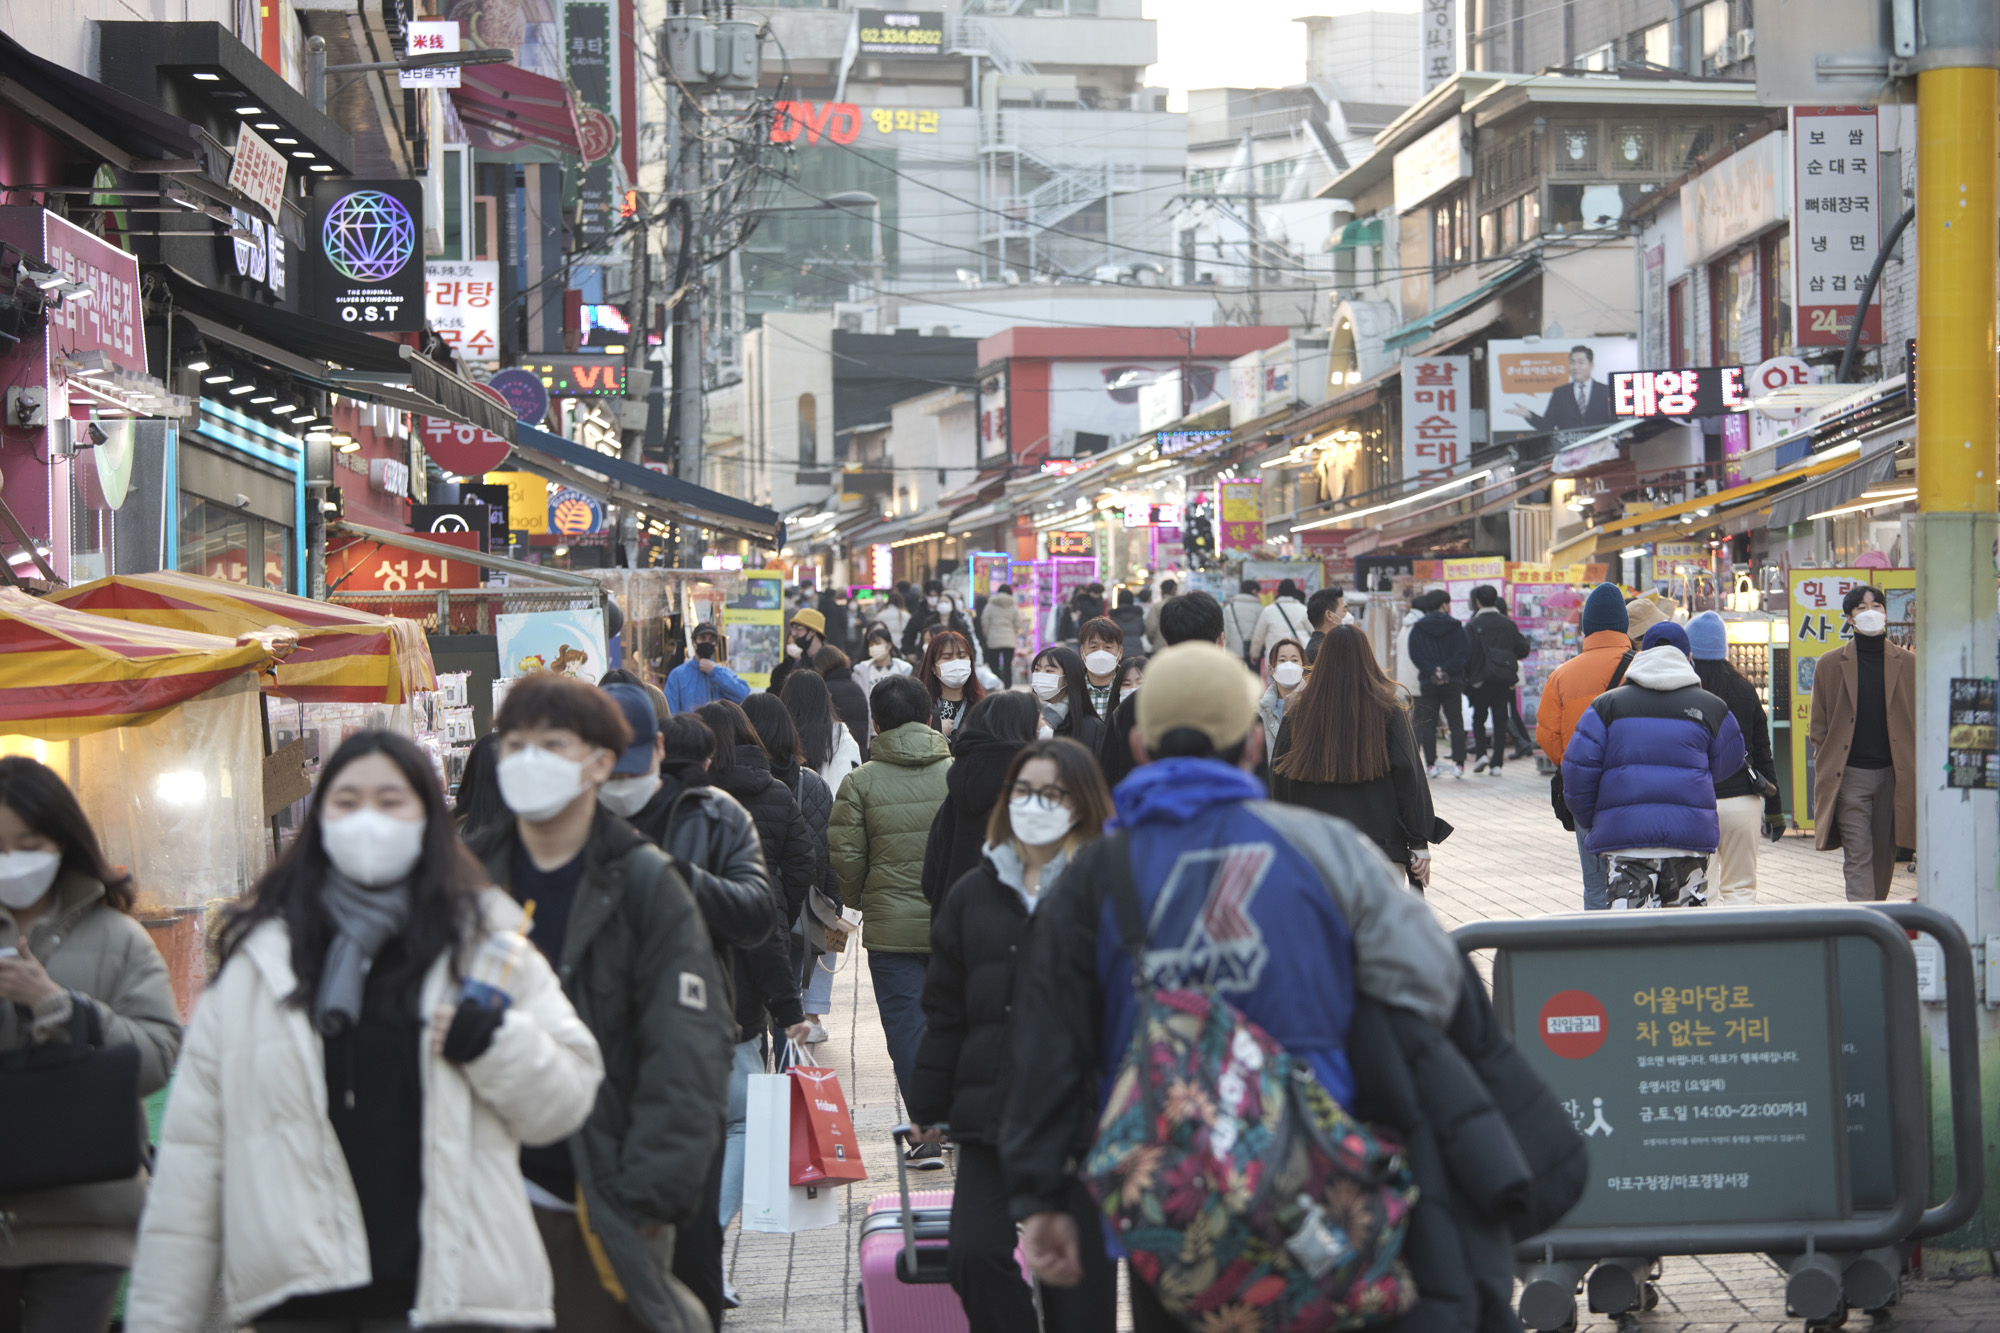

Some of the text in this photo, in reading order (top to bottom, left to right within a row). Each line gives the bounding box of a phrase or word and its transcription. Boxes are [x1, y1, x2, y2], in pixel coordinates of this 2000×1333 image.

[413, 34, 444, 49] 米线
[769, 101, 940, 147] DVD 영화관
[1807, 158, 1867, 175] 순대국
[1805, 196, 1870, 213] 뼈해장국
[341, 305, 399, 323] O.S.T
[1811, 309, 1852, 334] 24
[1614, 370, 1699, 416] 태양
[1633, 985, 1754, 1014] 어울마당로
[1550, 1017, 1598, 1032] 진입금지
[1635, 1016, 1770, 1047] 차 없는 거리
[1637, 1055, 1665, 1068] 걸으면
[1709, 1052, 1738, 1064] 마포가
[1638, 1077, 1726, 1094] 운영시간 (요일제)
[815, 1099, 839, 1113] Frisbee
[1639, 1101, 1808, 1122] 금.토.일 14:00~22:00까지
[1608, 1173, 1750, 1191] 마포구청장/마포경찰서장
